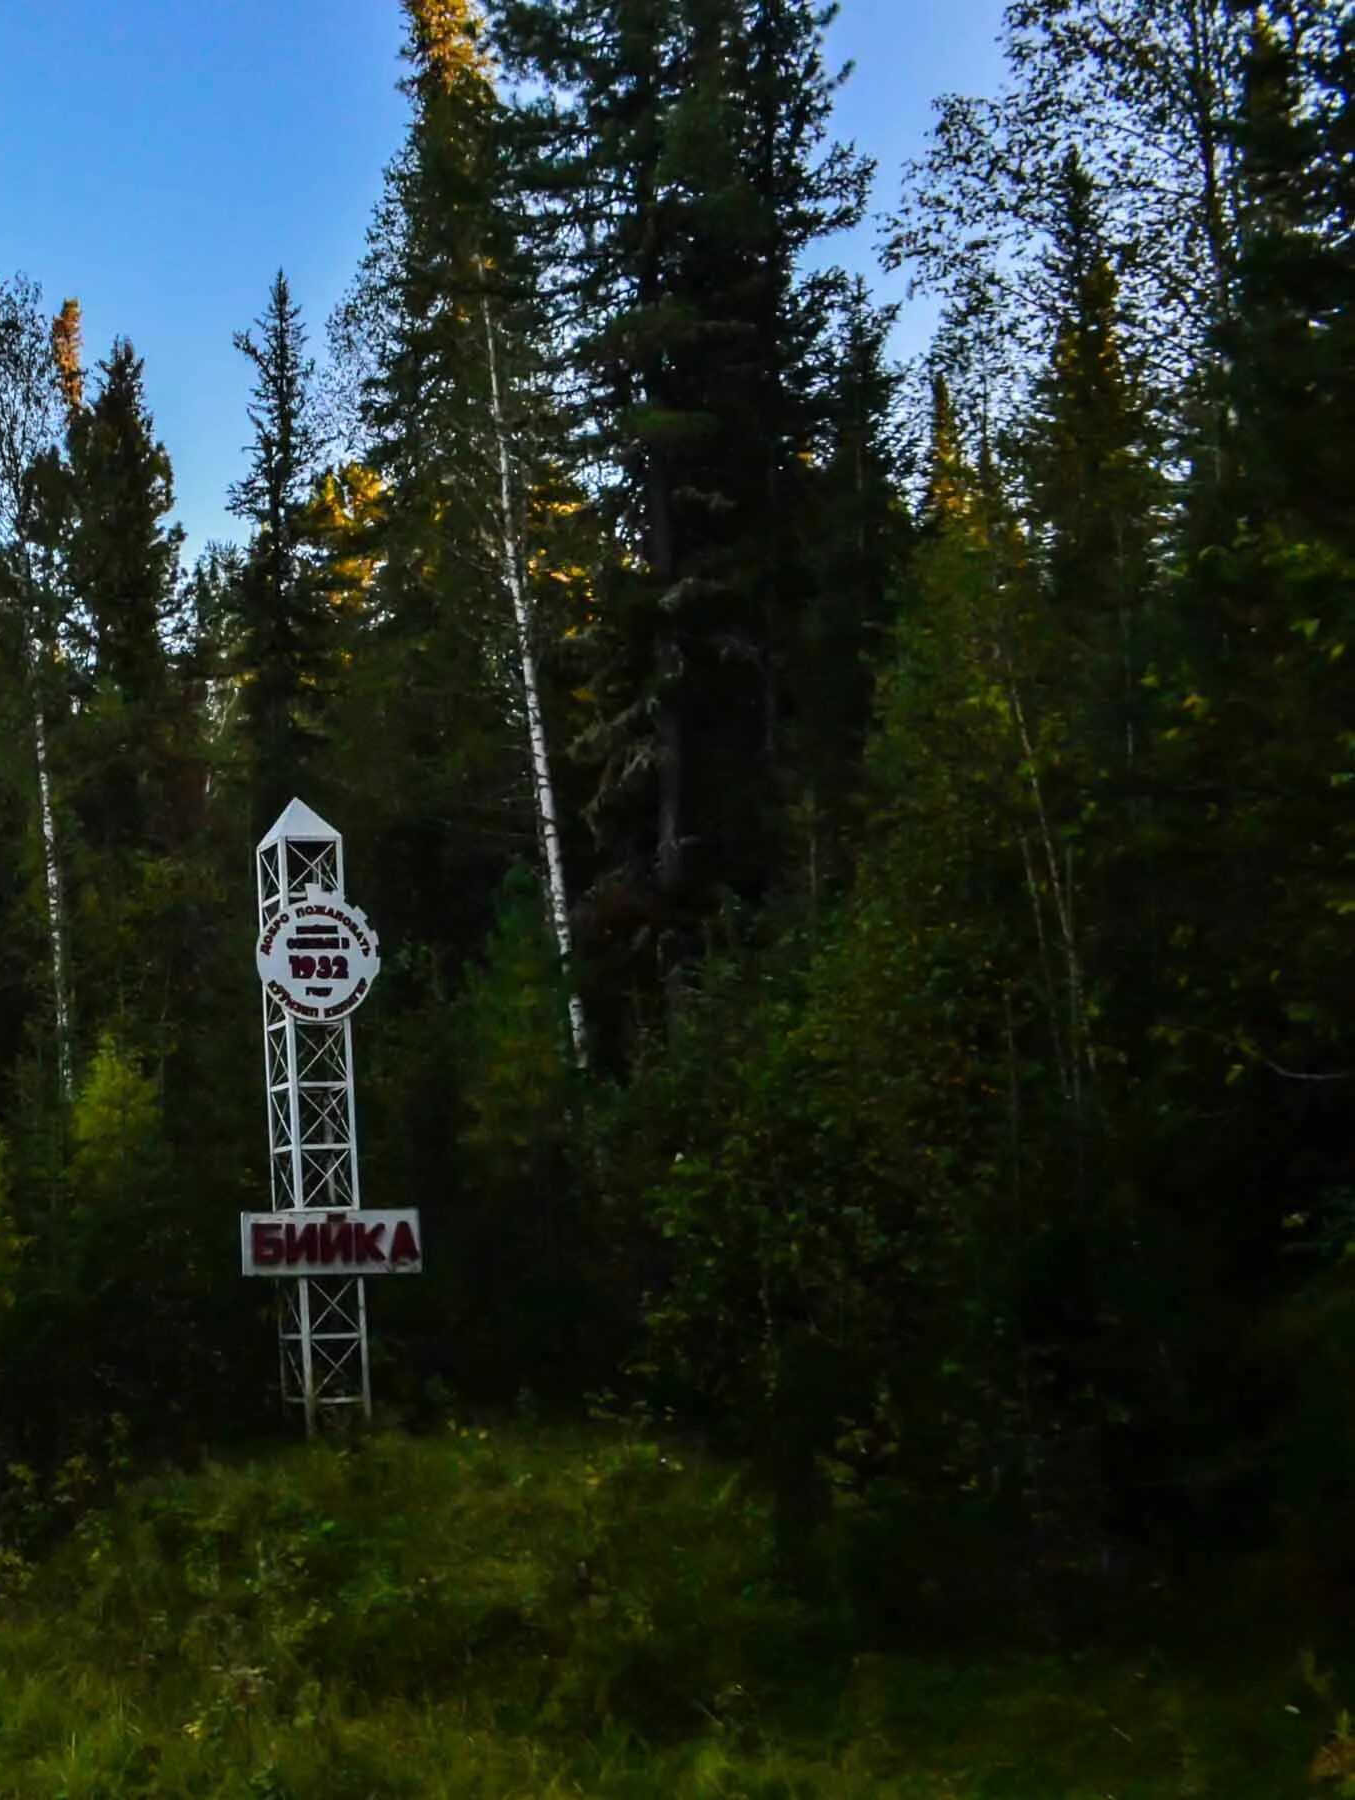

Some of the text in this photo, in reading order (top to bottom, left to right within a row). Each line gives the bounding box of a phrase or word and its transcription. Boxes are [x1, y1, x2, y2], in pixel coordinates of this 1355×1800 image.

[260, 904, 371, 957] ДОБРО ПОЖАЛОВАТЬ
[288, 955, 350, 979] 1932
[250, 1213, 420, 1266] БИЙКА
